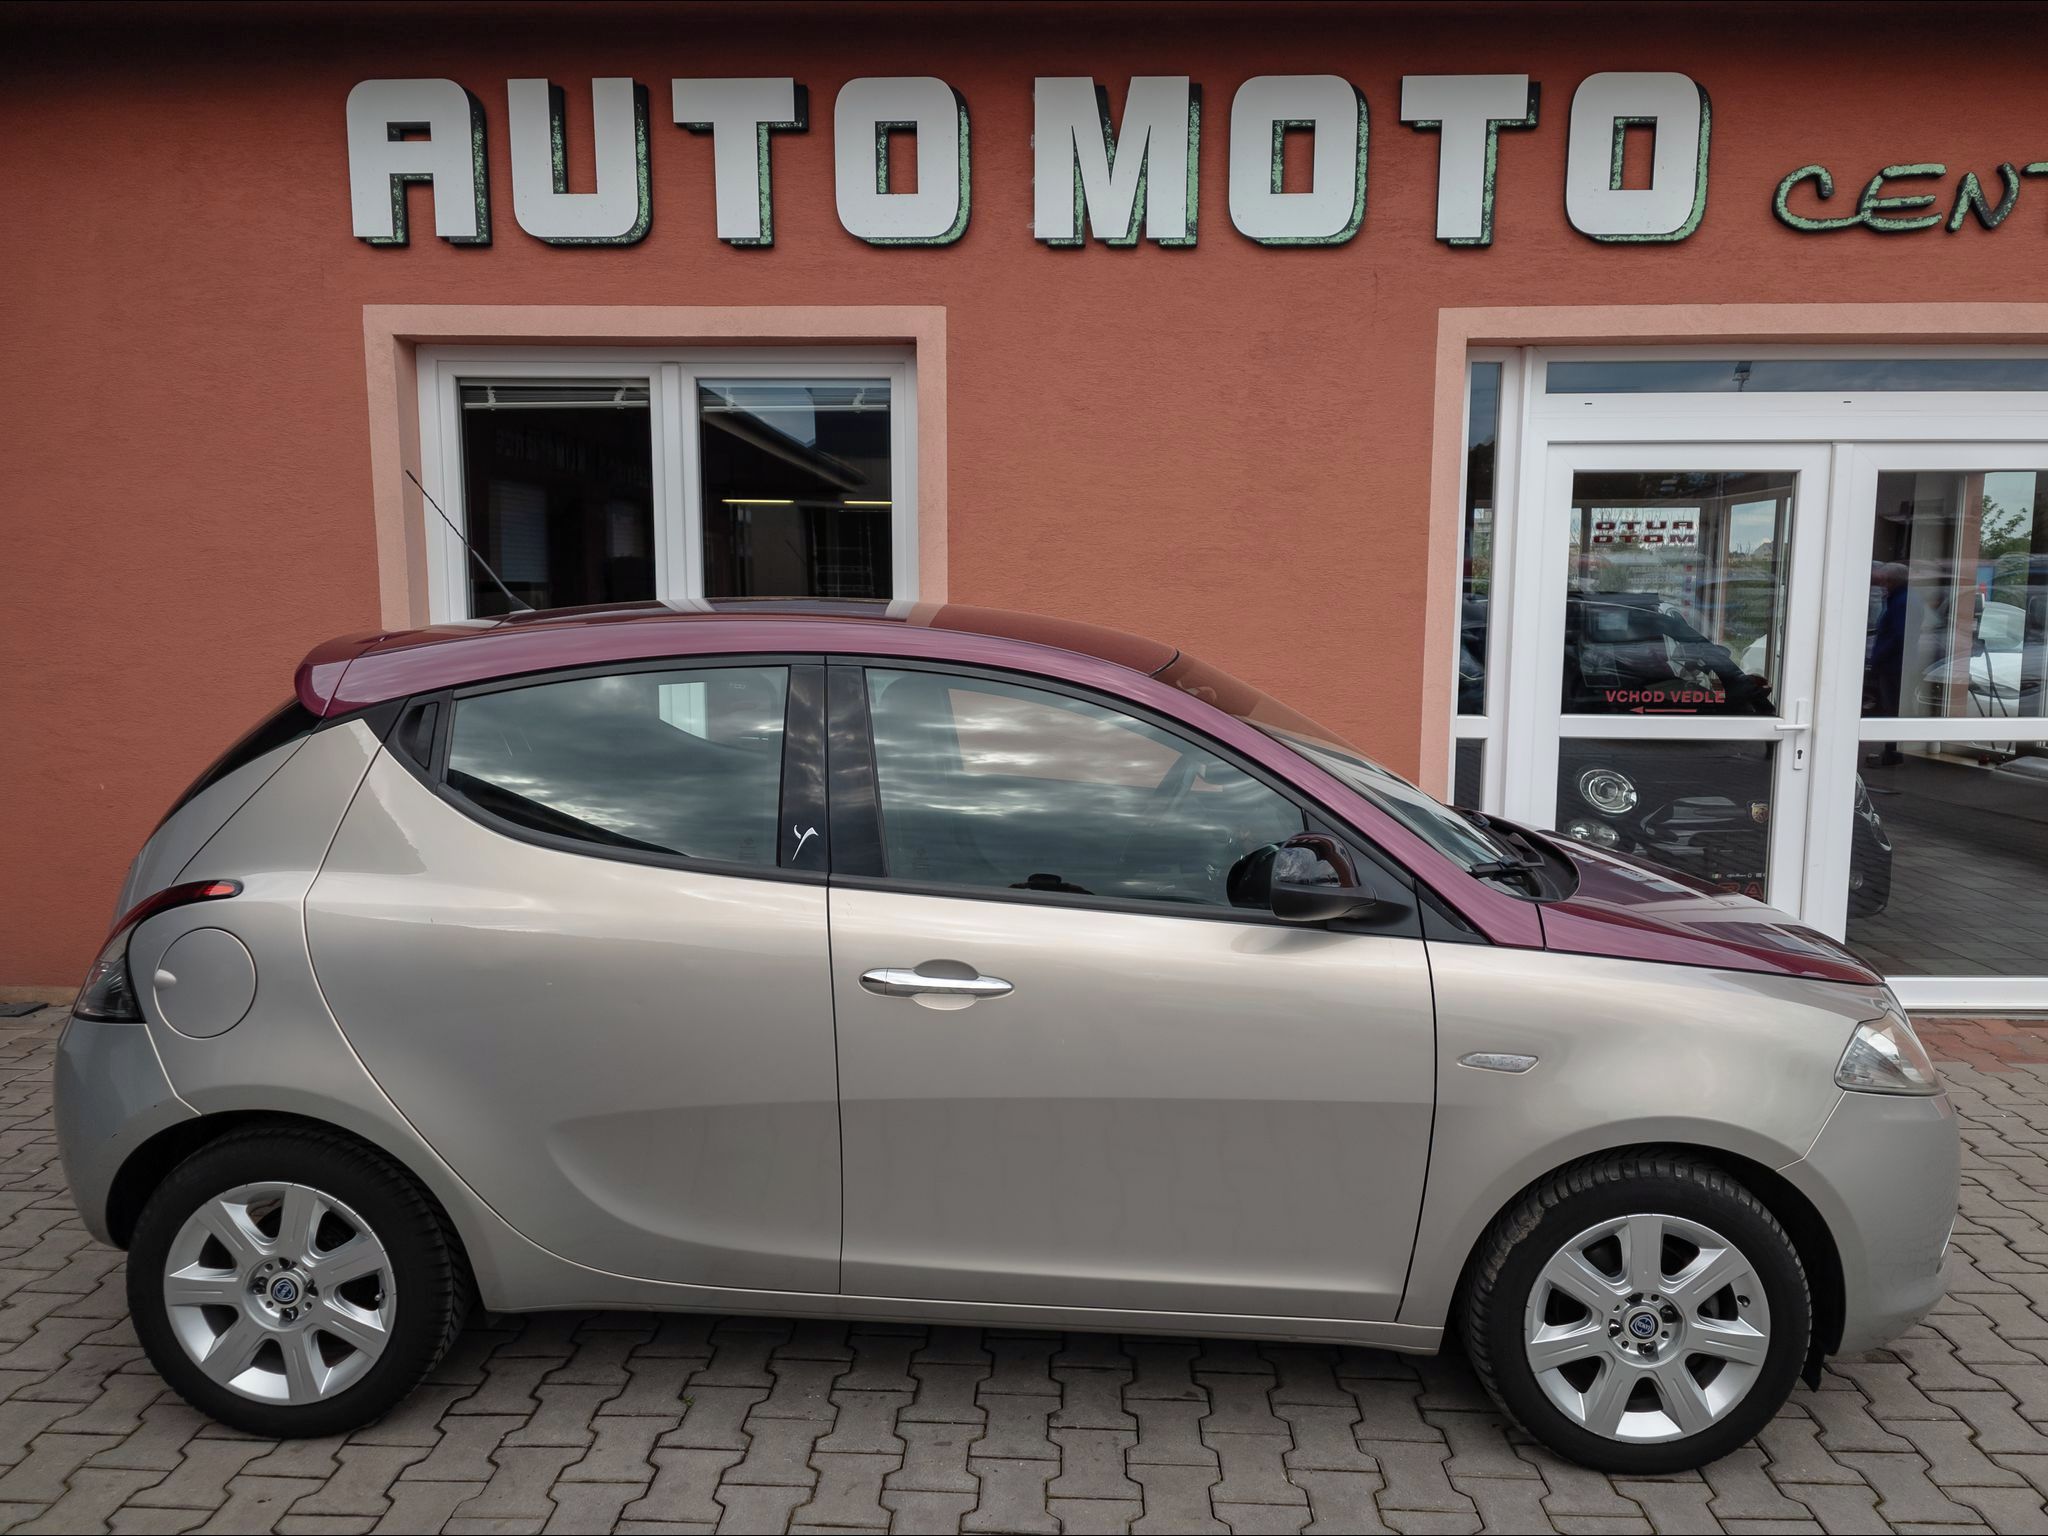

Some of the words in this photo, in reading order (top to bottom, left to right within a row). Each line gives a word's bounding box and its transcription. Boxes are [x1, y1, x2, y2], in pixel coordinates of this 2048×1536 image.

[346, 76, 972, 248] AUTO
[1033, 71, 1711, 248] MOTO
[1604, 690, 1666, 703] VCHOD
[1669, 690, 1726, 704] VEDLE
